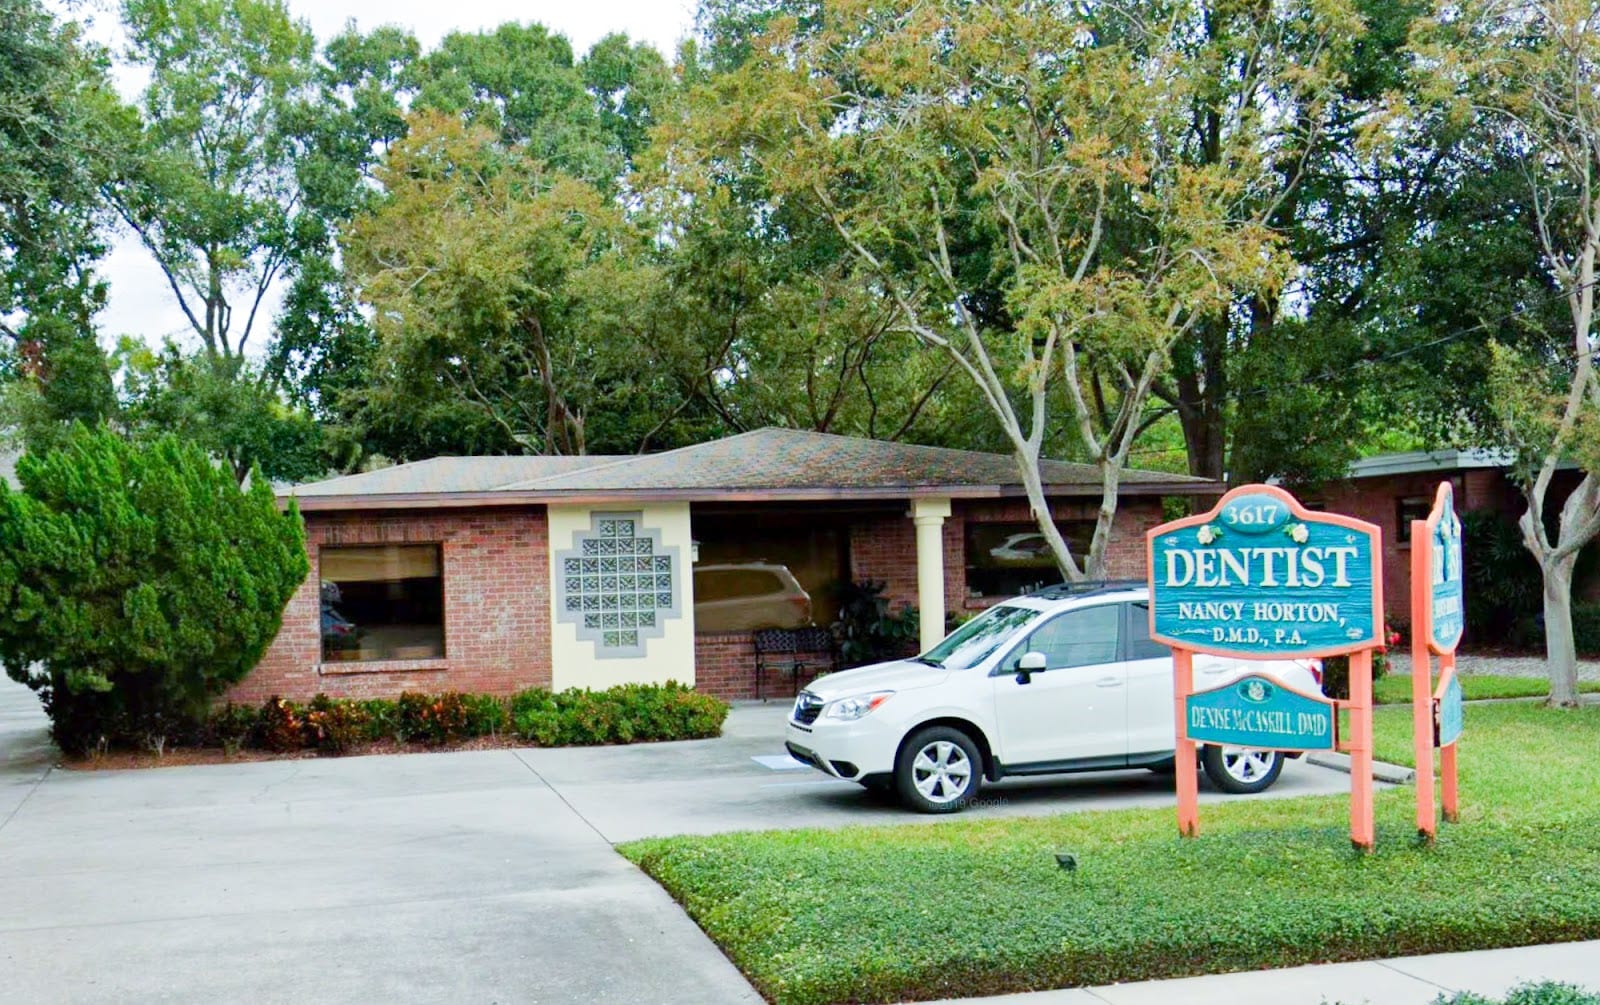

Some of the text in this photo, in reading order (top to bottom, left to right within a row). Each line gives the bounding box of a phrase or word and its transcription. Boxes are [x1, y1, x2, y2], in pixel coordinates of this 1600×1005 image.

[1228, 505, 1277, 525] 3617
[1164, 547, 1358, 588] DENTIST
[1179, 602, 1345, 627] NANCY HORTON,
[1275, 628, 1307, 645] P.A.
[1191, 706, 1231, 730] DENISE
[1298, 712, 1327, 736] DMD
